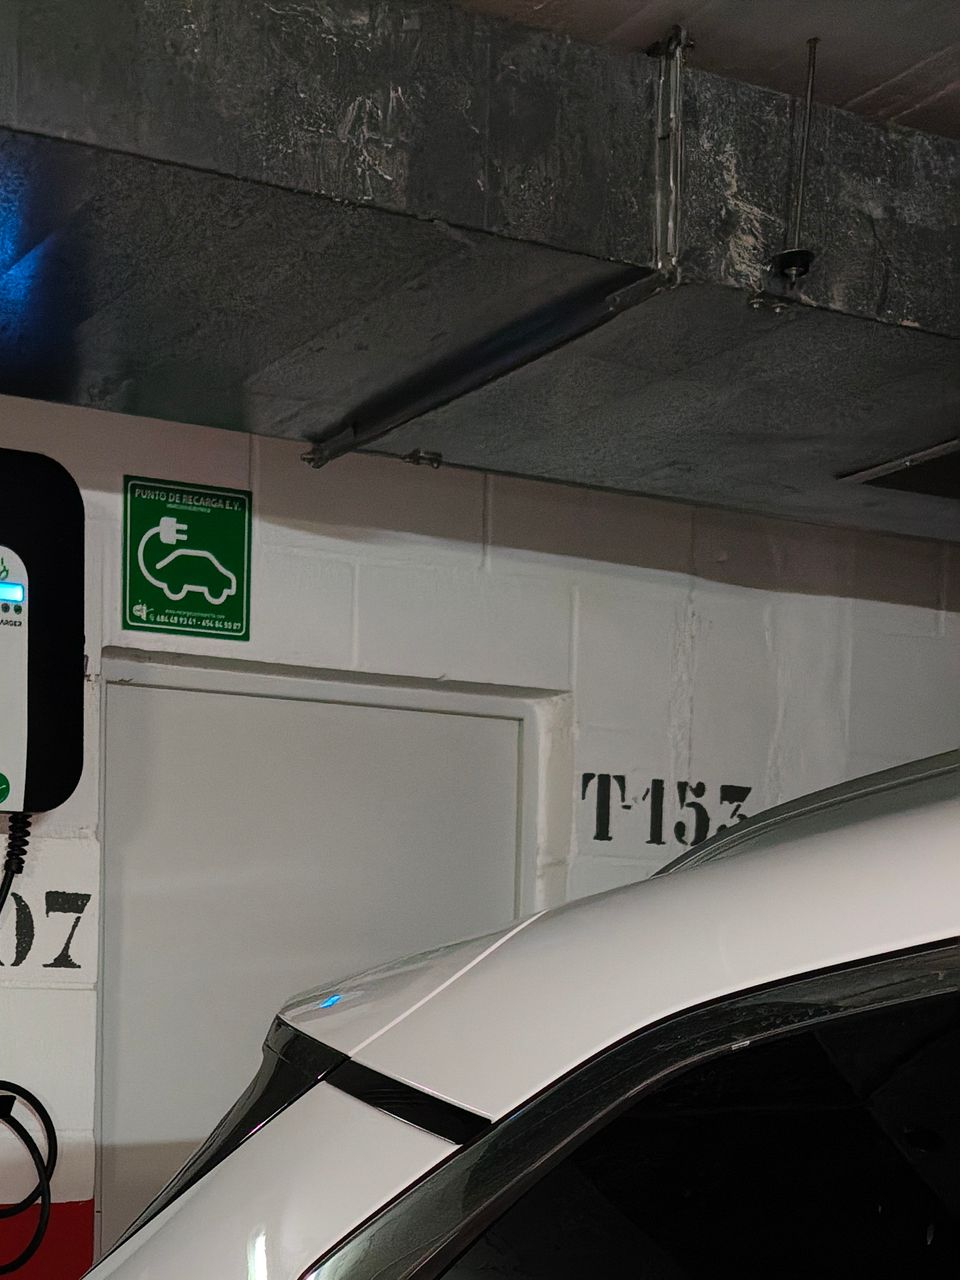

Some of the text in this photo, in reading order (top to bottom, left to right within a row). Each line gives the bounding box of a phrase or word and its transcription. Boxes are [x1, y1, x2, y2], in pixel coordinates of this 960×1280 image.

[135, 488, 167, 501] PUNTO
[168, 493, 180, 504] DE
[182, 495, 224, 509] RECARGA
[225, 500, 241, 511] E.V.
